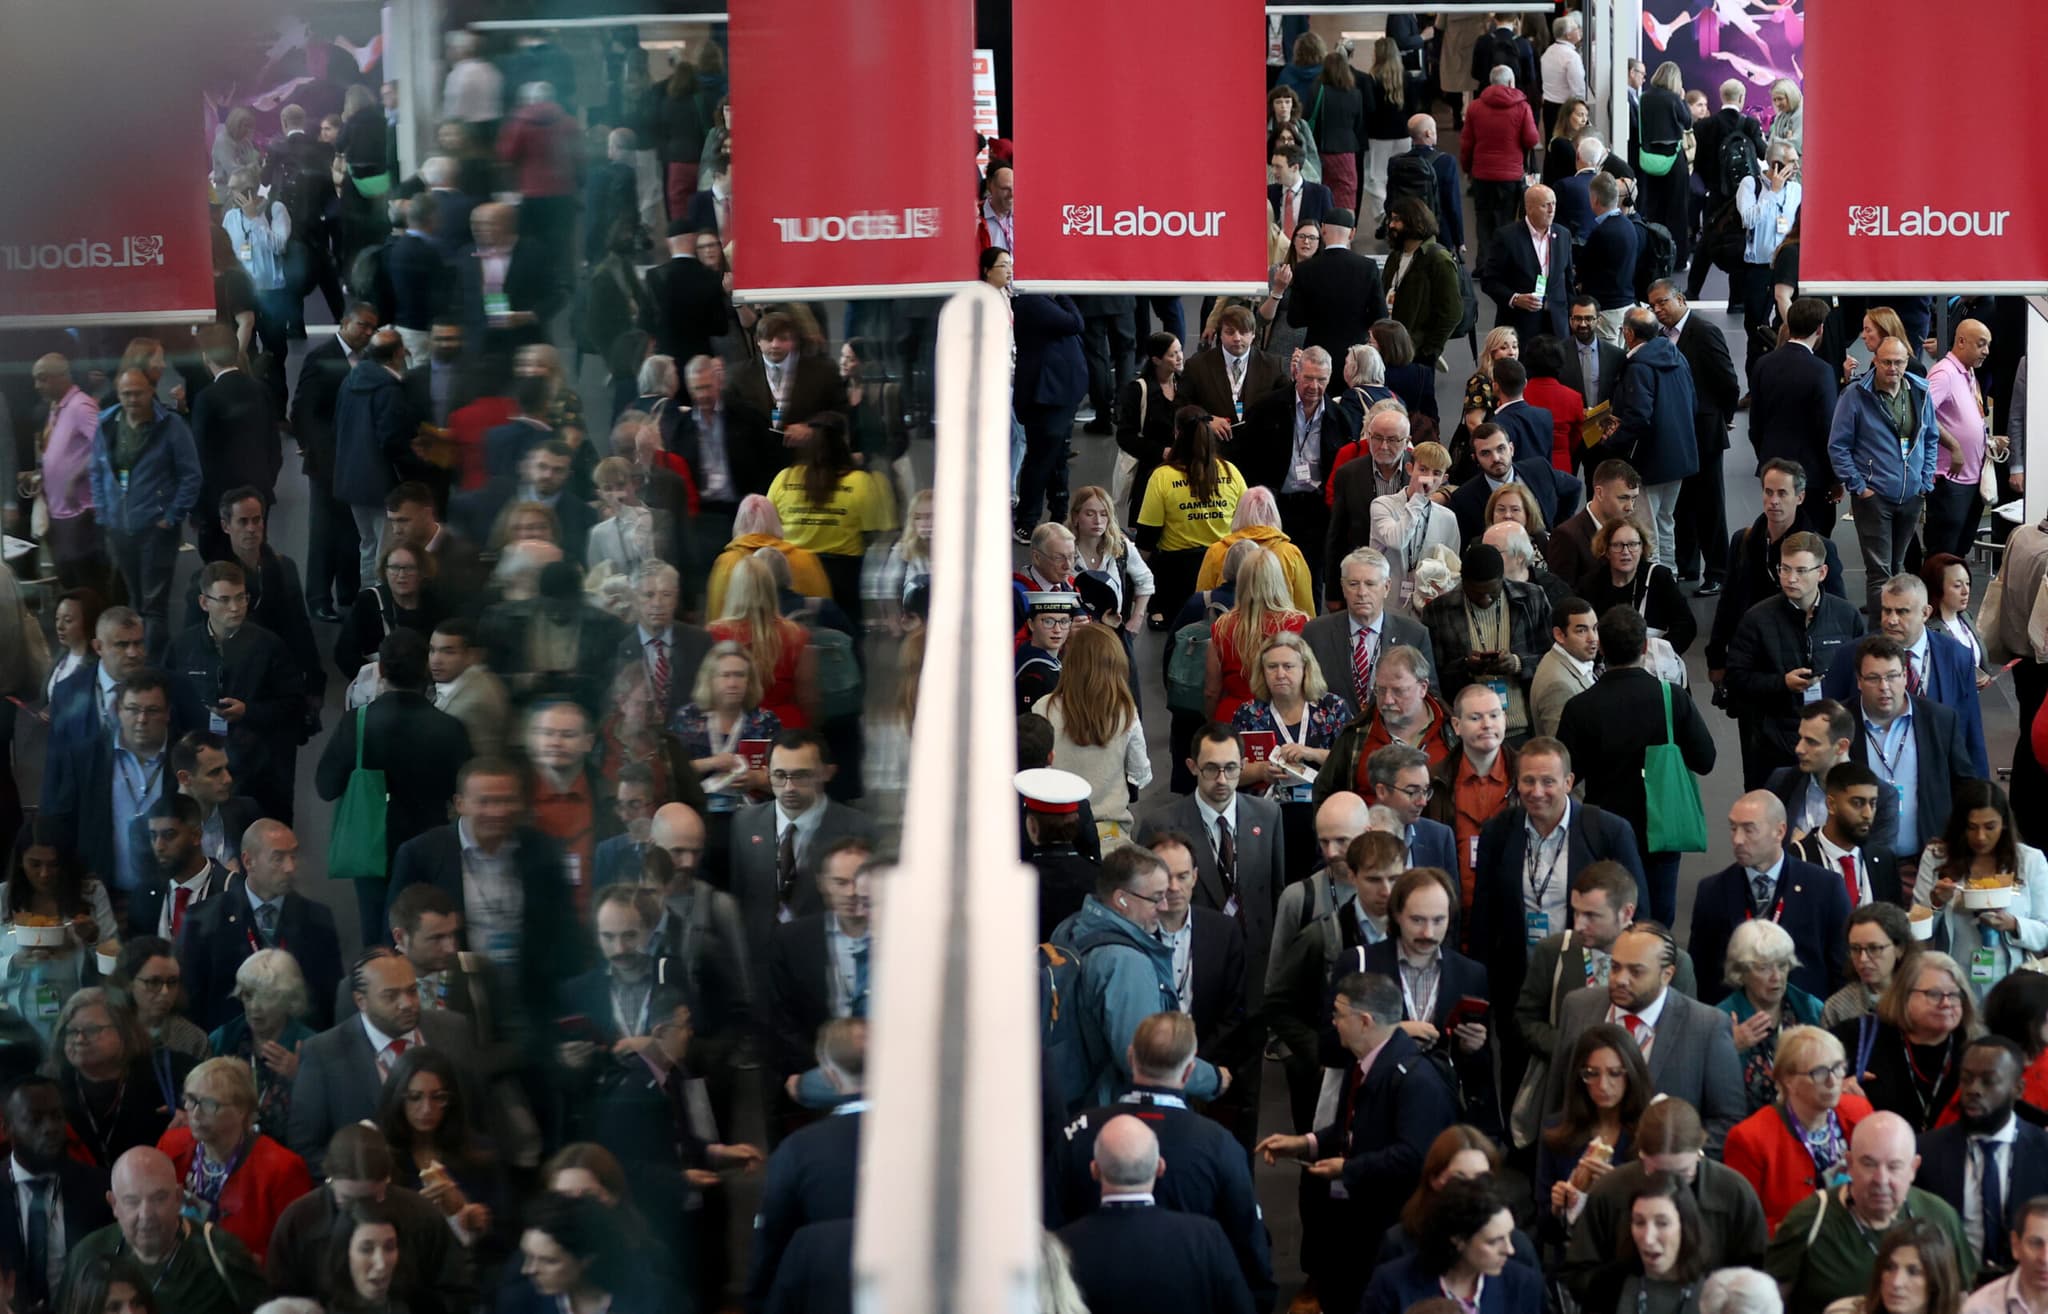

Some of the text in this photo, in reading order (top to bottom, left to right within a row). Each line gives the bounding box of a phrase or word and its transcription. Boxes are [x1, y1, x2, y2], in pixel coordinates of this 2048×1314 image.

[1096, 205, 1226, 237] Labour
[1882, 205, 2010, 237] Labour
[1187, 511, 1224, 520] SUICIDE
